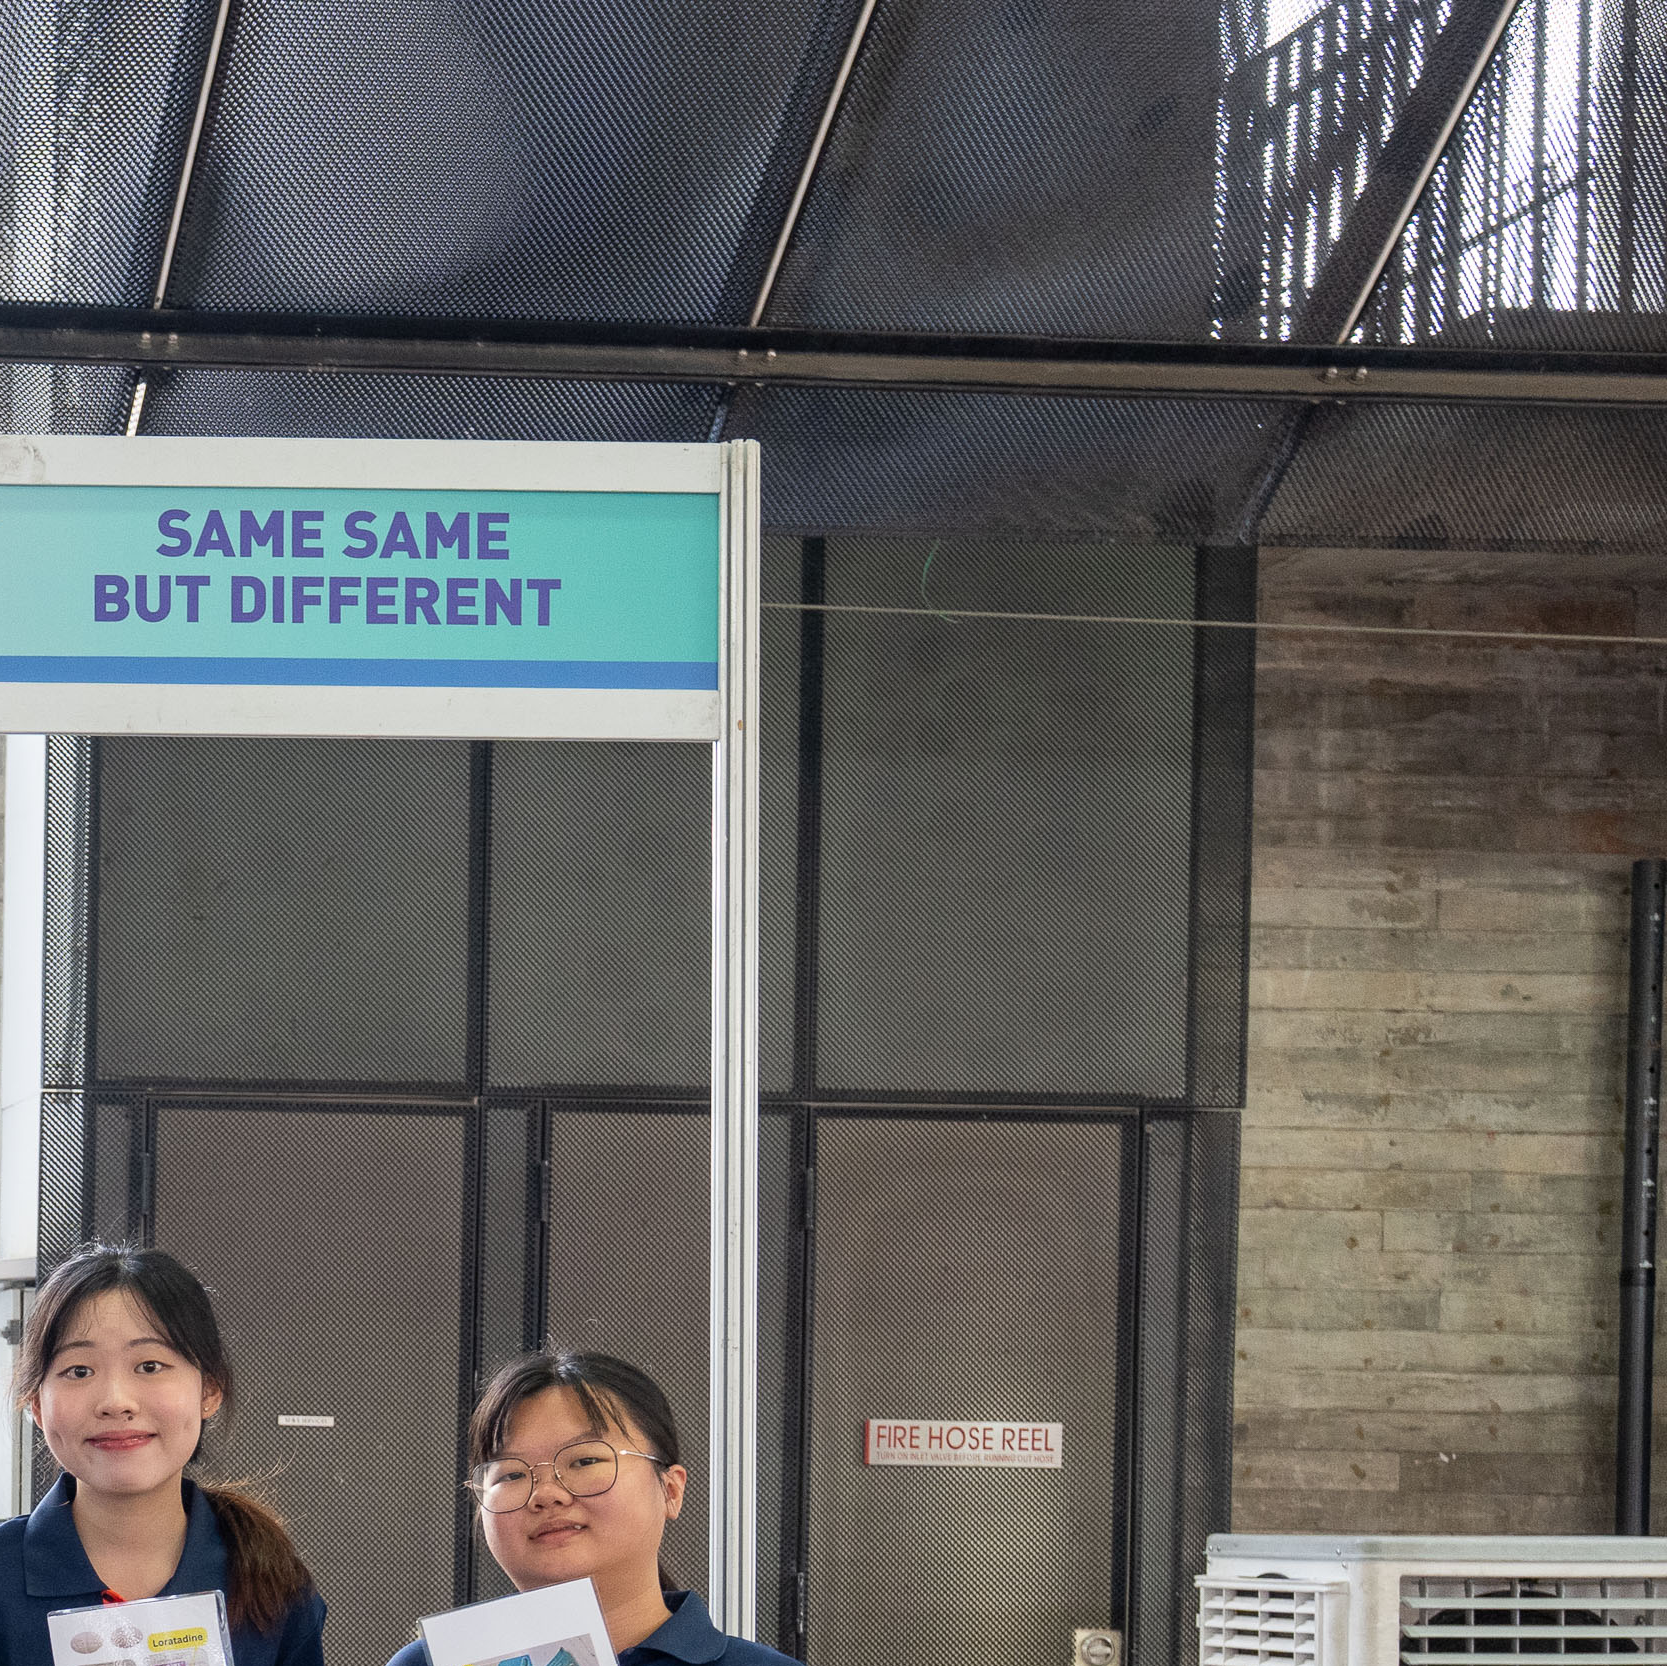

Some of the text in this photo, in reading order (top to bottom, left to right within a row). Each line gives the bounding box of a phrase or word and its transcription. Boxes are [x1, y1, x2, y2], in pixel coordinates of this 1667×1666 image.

[155, 508, 510, 561] SAME SAME
[93, 574, 561, 627] BUT DIFFERENT
[876, 1425, 1055, 1451] FIRE HOSE REEL
[877, 1452, 1054, 1463] TURN ON INLET VALVE BEFORE RUNNING OUT HOSE
[152, 1633, 203, 1648] Loratadine
